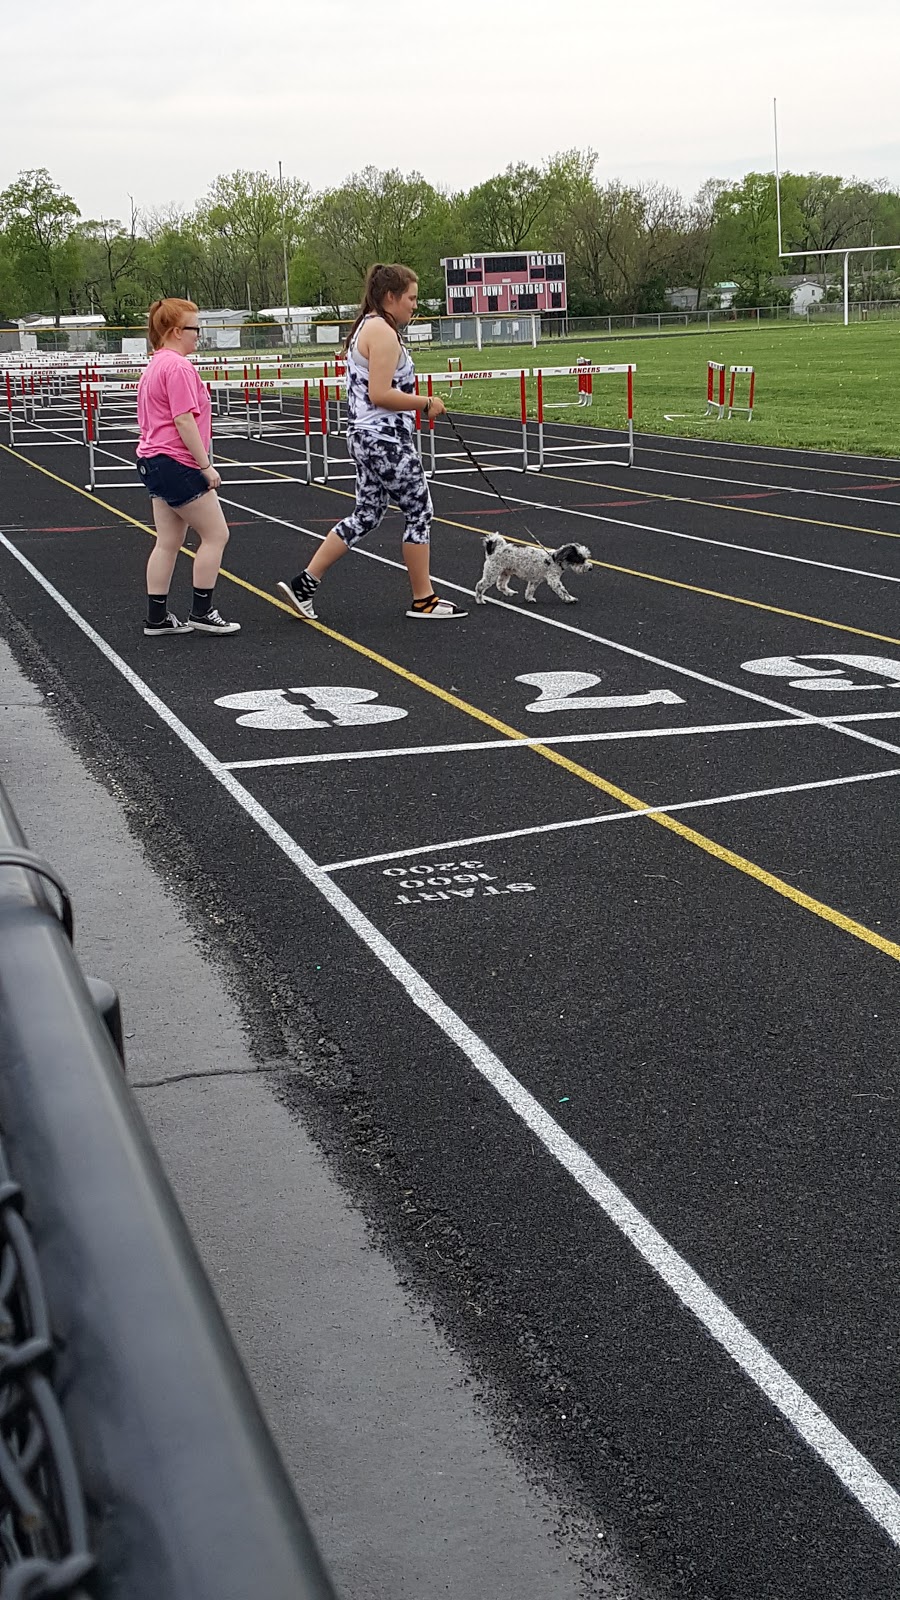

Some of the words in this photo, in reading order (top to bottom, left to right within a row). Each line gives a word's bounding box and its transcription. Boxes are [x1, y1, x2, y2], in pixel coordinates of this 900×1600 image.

[452, 258, 476, 269] HOME
[531, 254, 562, 266] GUESTS
[449, 287, 464, 298] BALL
[465, 286, 475, 297] ON
[482, 285, 503, 296] DOWN
[511, 284, 524, 295] YDS
[525, 284, 533, 294] TO
[534, 283, 544, 294] GO
[550, 282, 563, 293] QTR
[459, 371, 493, 379] LANCERS
[569, 366, 601, 374] LANCERS
[514, 671, 687, 713] 7
[213, 686, 409, 730] 8
[382, 860, 484, 877] 3200
[399, 873, 498, 889] 1600
[393, 882, 536, 905] START
